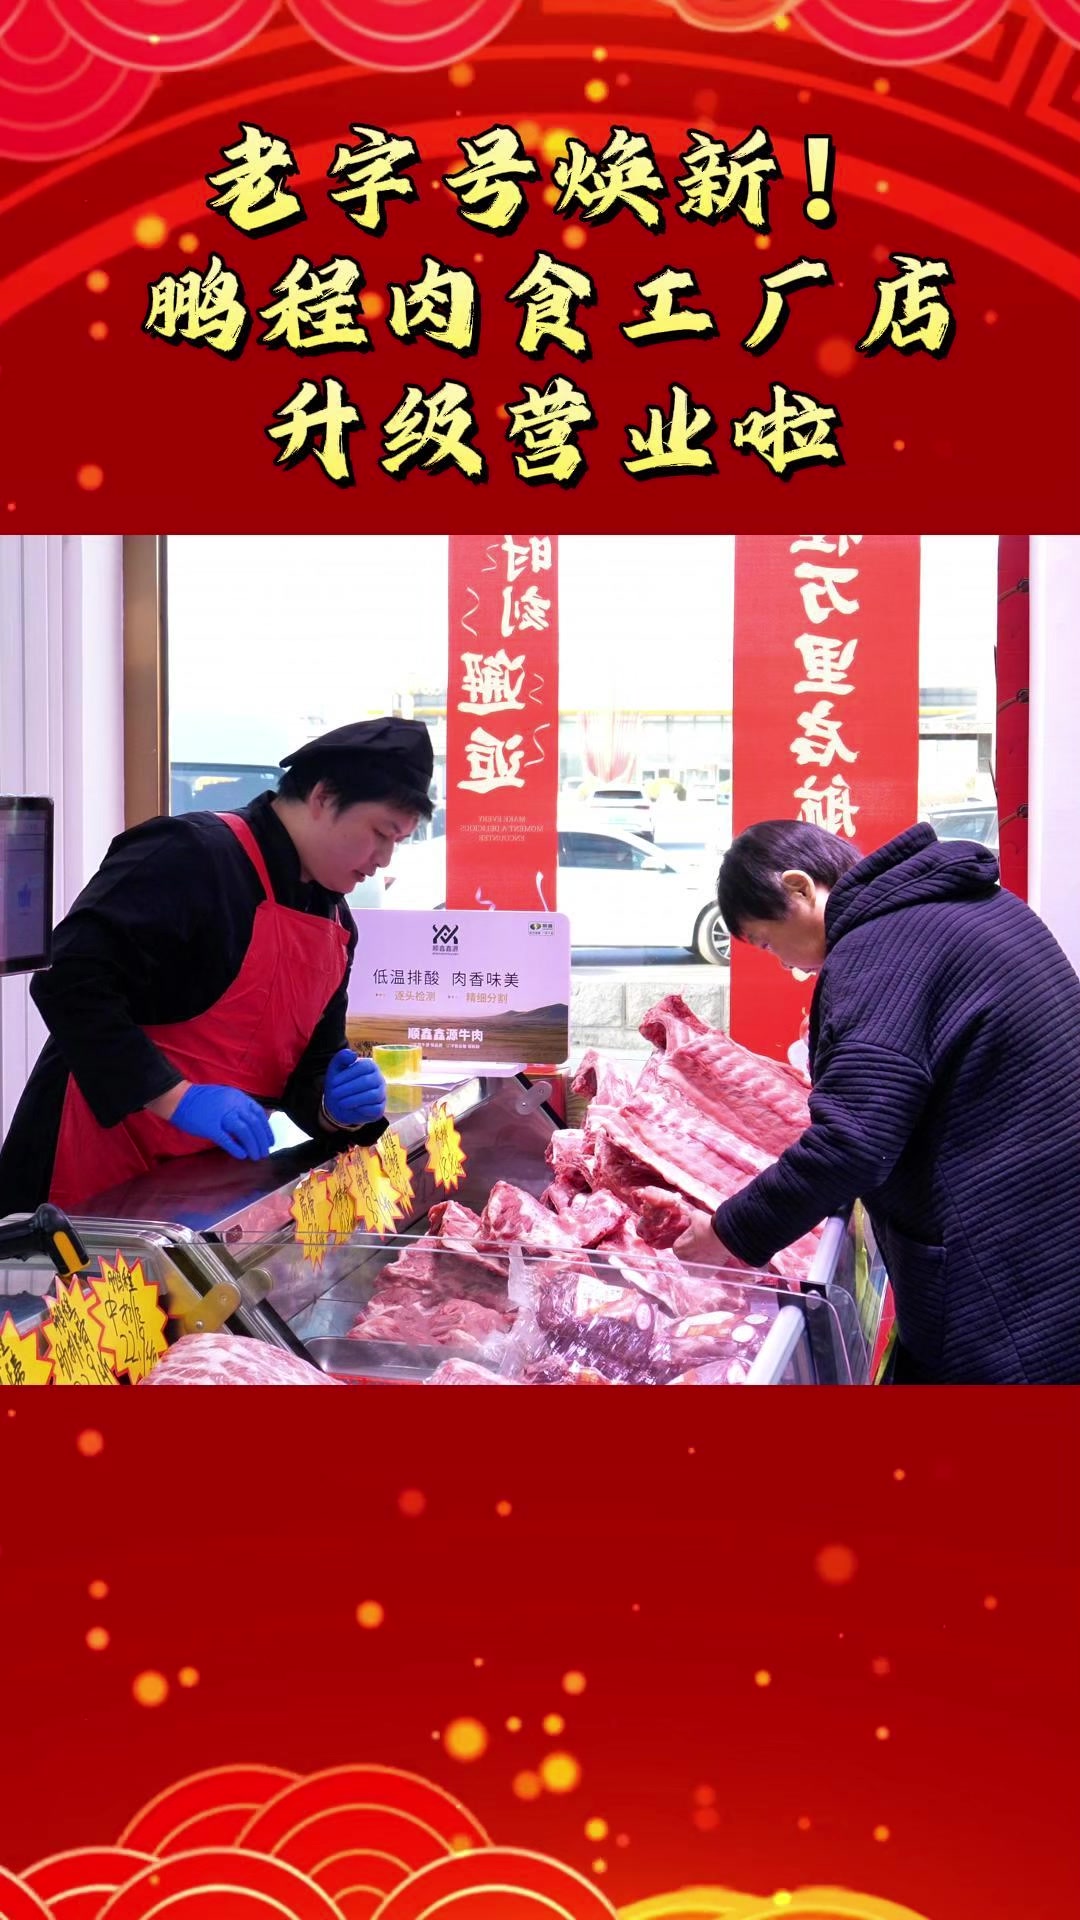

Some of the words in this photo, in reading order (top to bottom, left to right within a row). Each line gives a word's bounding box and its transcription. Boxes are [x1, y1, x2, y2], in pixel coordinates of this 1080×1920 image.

[373, 969, 440, 986] 低温排酸
[452, 971, 519, 988] 肉香味美
[394, 990, 436, 1002] 逐头检测
[466, 992, 508, 1004] 精细分割
[407, 1027, 484, 1042] 顺鑫鑫源牛肉
